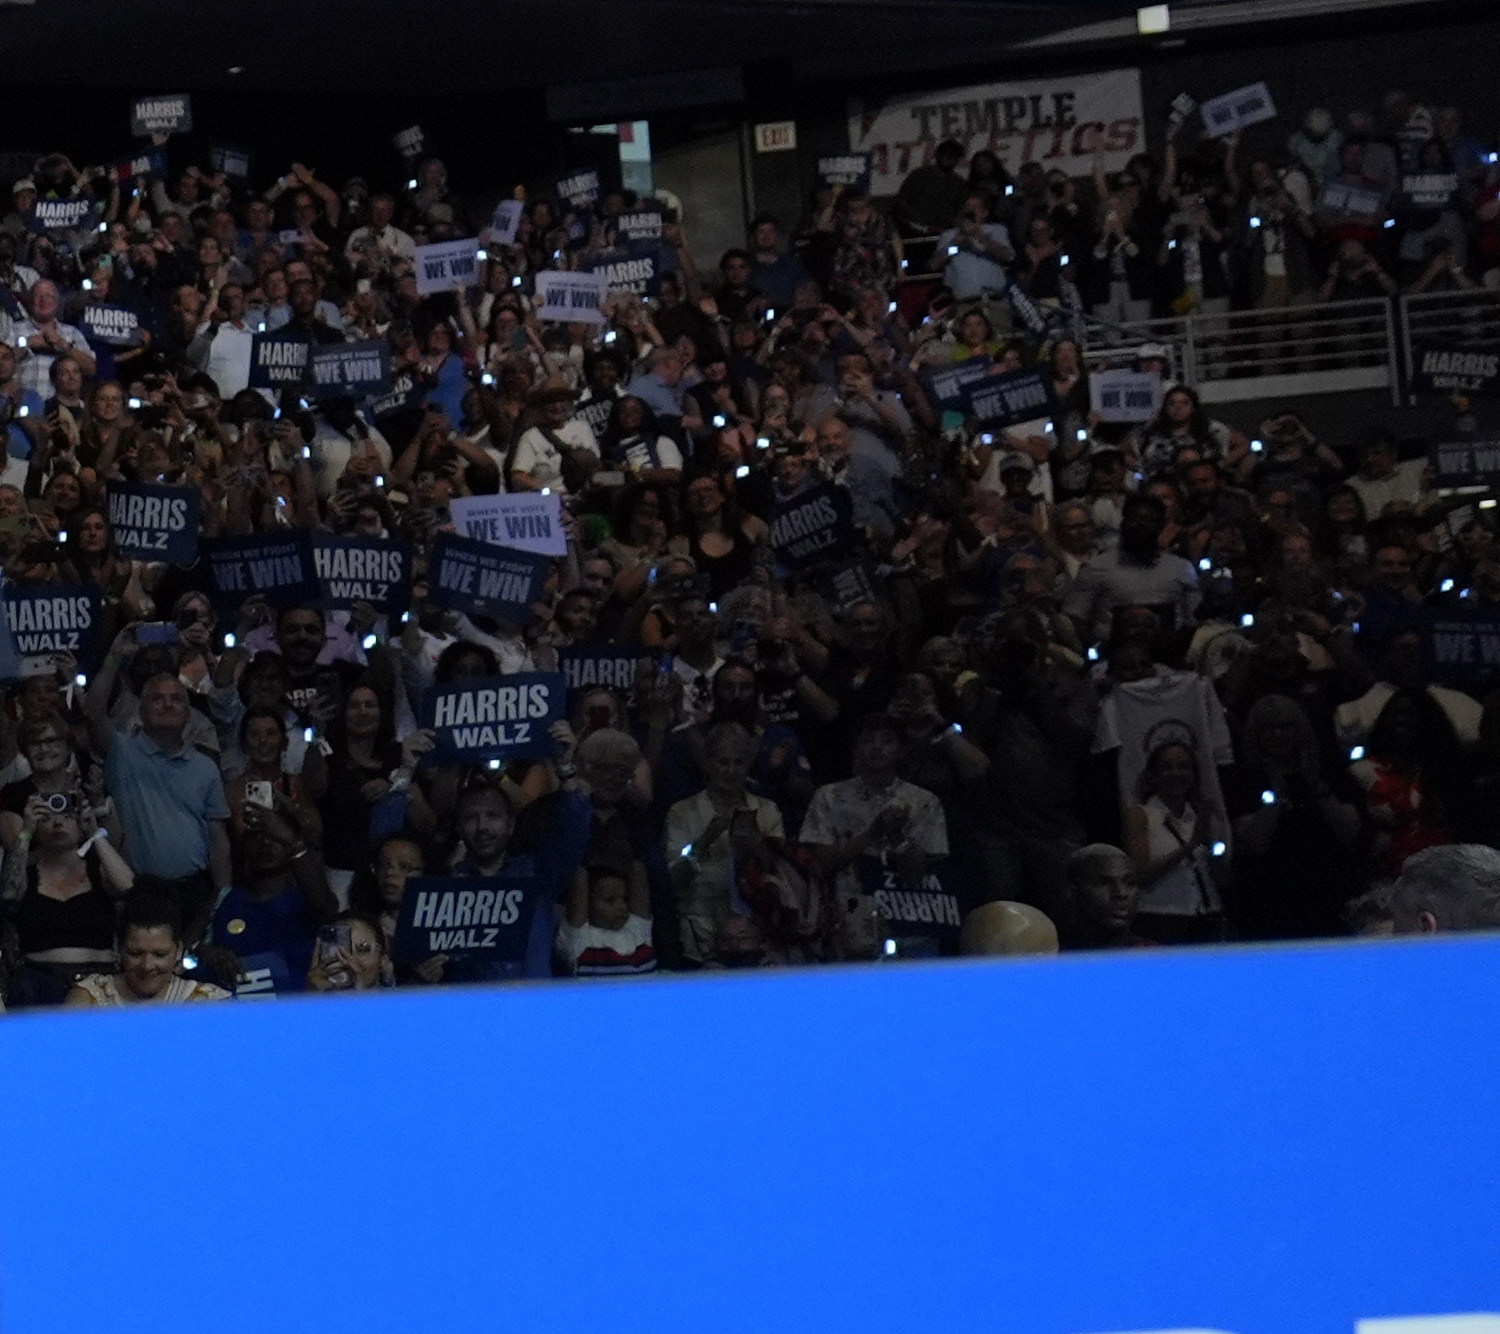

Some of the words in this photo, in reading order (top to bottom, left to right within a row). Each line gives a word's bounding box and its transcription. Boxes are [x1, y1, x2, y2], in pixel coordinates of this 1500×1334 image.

[911, 91, 1076, 140] TEMPLE
[865, 117, 1142, 175] ATETICS
[35, 199, 90, 222] HARRIS
[573, 287, 601, 308] WIN
[84, 304, 139, 332] HARRIS
[314, 361, 342, 385] WE
[346, 358, 383, 382] WIN
[109, 492, 188, 532] HARRIS
[466, 520, 502, 543] WE
[505, 515, 551, 541] WIN
[768, 495, 839, 548] HARRIS
[113, 529, 169, 551] WALZ
[212, 564, 248, 593] WE
[252, 554, 302, 587] WIN
[313, 547, 404, 583] HARRIS
[329, 580, 390, 603] WALZ
[438, 562, 482, 595] WE
[486, 569, 532, 605] WIN
[1, 596, 91, 632] HARRIS
[17, 632, 80, 652] WALZ
[433, 683, 551, 729] HARRIS
[452, 722, 532, 750] WALZ
[412, 889, 524, 929] HARRIS
[873, 889, 961, 928] HARRIS
[428, 927, 501, 953] WALZ
